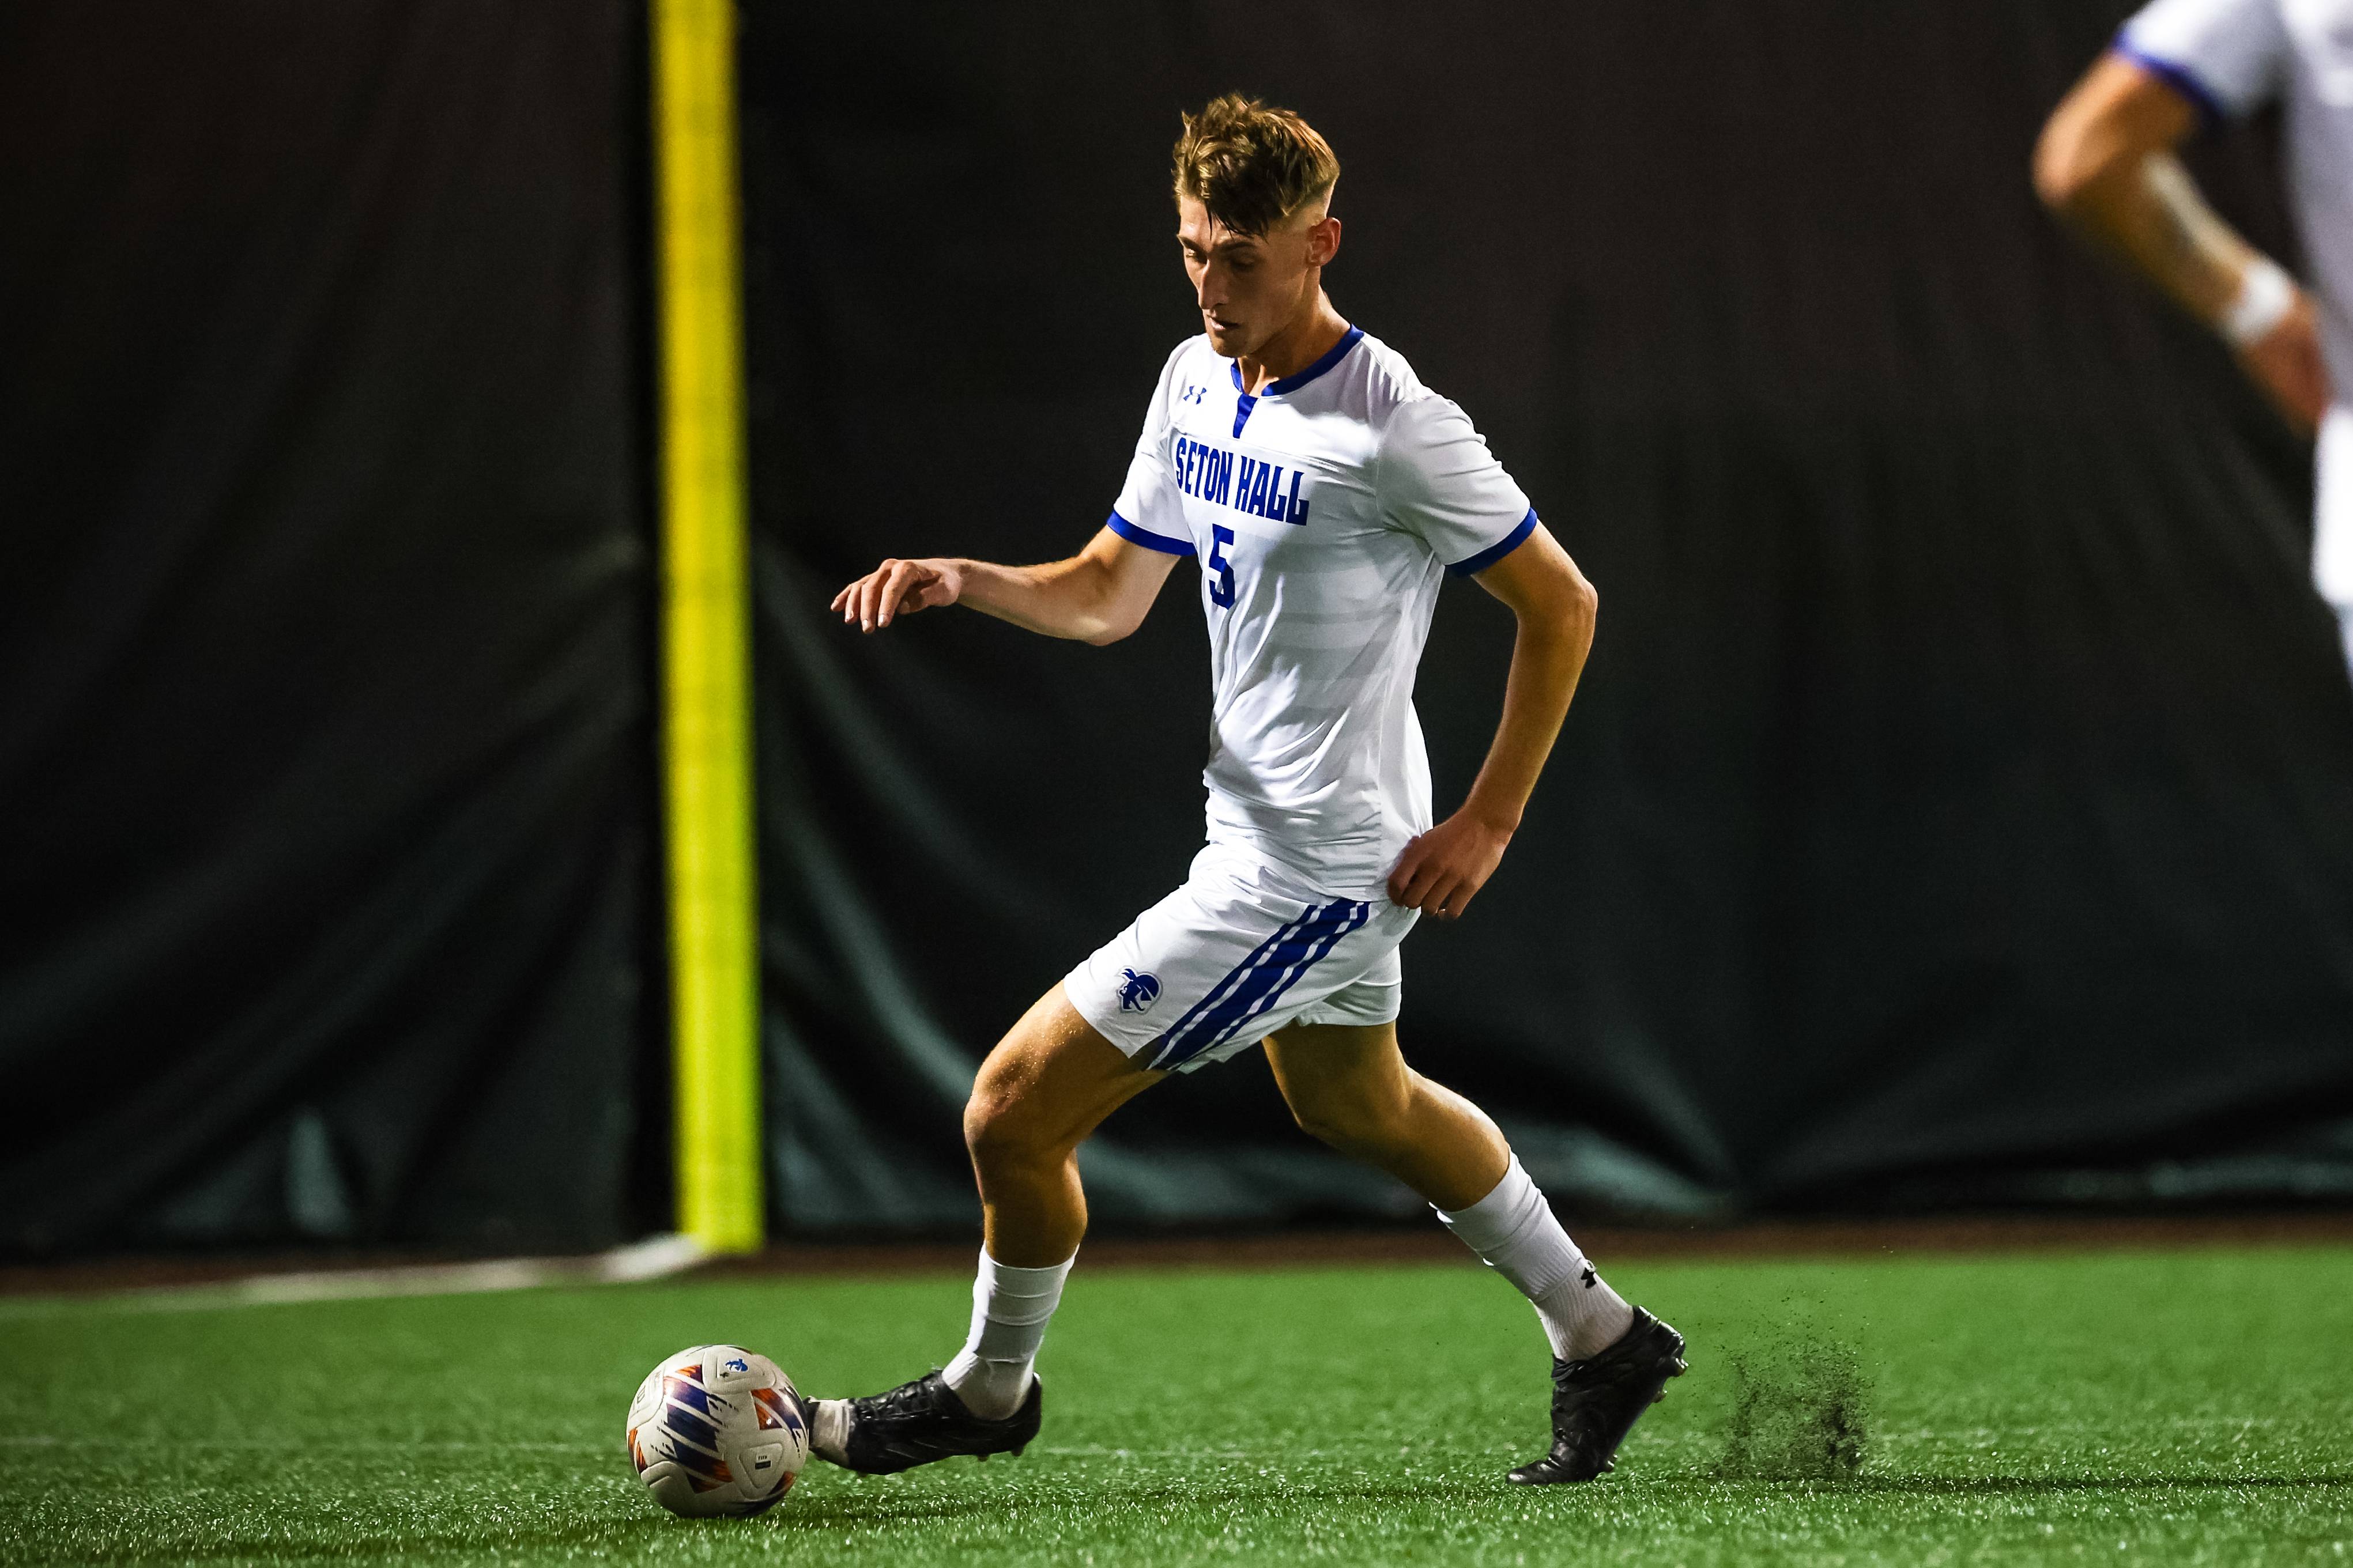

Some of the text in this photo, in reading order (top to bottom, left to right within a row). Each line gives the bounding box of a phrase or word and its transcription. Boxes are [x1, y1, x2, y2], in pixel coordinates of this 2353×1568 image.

[1175, 437, 1310, 526] SETON HALL
[1209, 523, 1235, 610] 5
